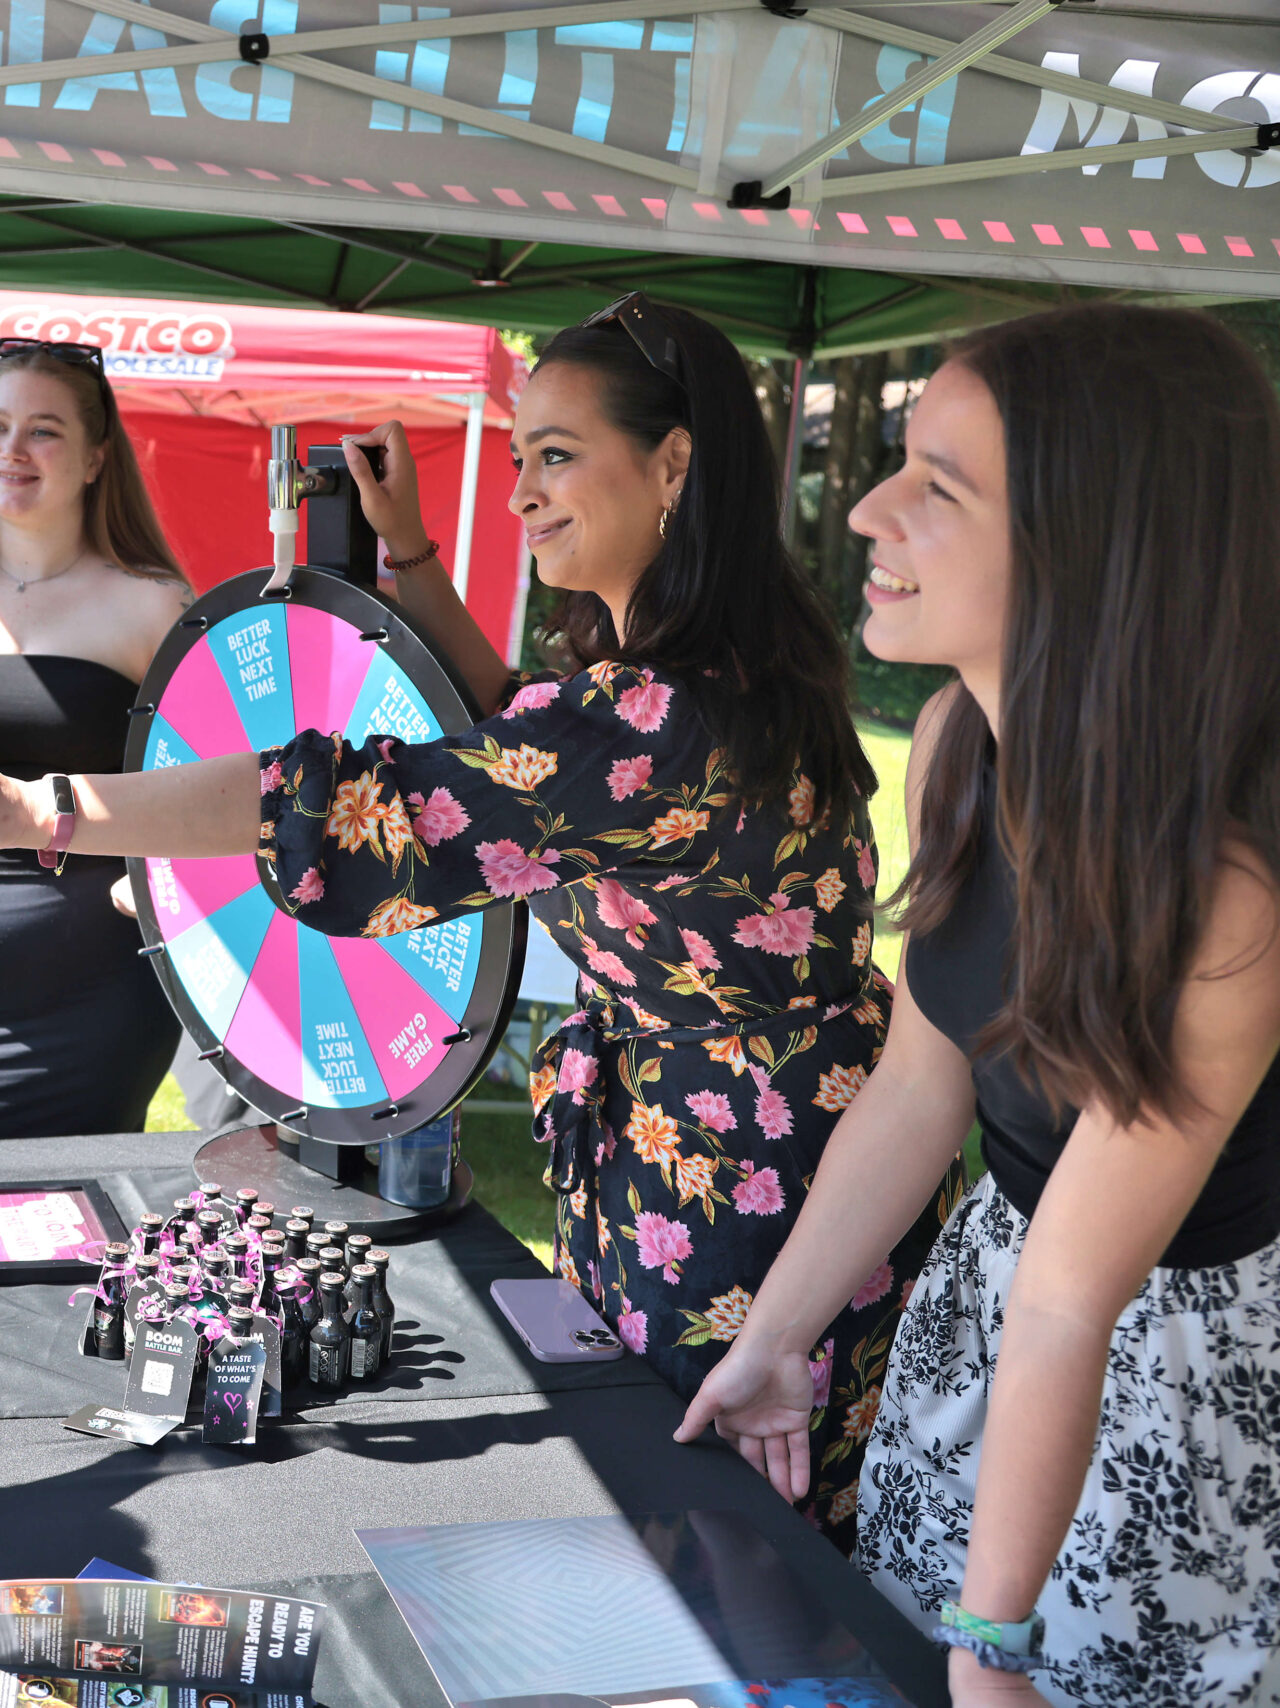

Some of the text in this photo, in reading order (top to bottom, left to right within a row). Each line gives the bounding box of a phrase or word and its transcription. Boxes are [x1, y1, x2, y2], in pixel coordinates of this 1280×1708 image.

[227, 619, 272, 651] BETTER
[236, 638, 270, 666] LUCK
[239, 656, 274, 684] NEXT
[245, 676, 277, 702] TIME
[380, 694, 416, 745] LUCK
[384, 675, 430, 741] BETTER
[152, 867, 169, 908] FREE
[407, 929, 424, 954] ME
[434, 922, 457, 976] LUCK
[446, 921, 472, 992] BETTER
[316, 1022, 349, 1041] TIME
[388, 1012, 428, 1059] GAME
[318, 1041, 354, 1060] NEXT
[403, 1033, 434, 1070] FREE
[323, 1060, 358, 1079] LUCK
[144, 1341, 167, 1351] BATTLE
[145, 1330, 183, 1347] BOOM
[214, 1365, 256, 1373] OF WHAT'S
[222, 1355, 252, 1363] A TASTE
[217, 1375, 251, 1383] TO COME
[241, 1599, 265, 1685] ESCAPE HUNT?
[268, 1602, 290, 1658] READY TO
[294, 1606, 315, 1656] ARE YOU
